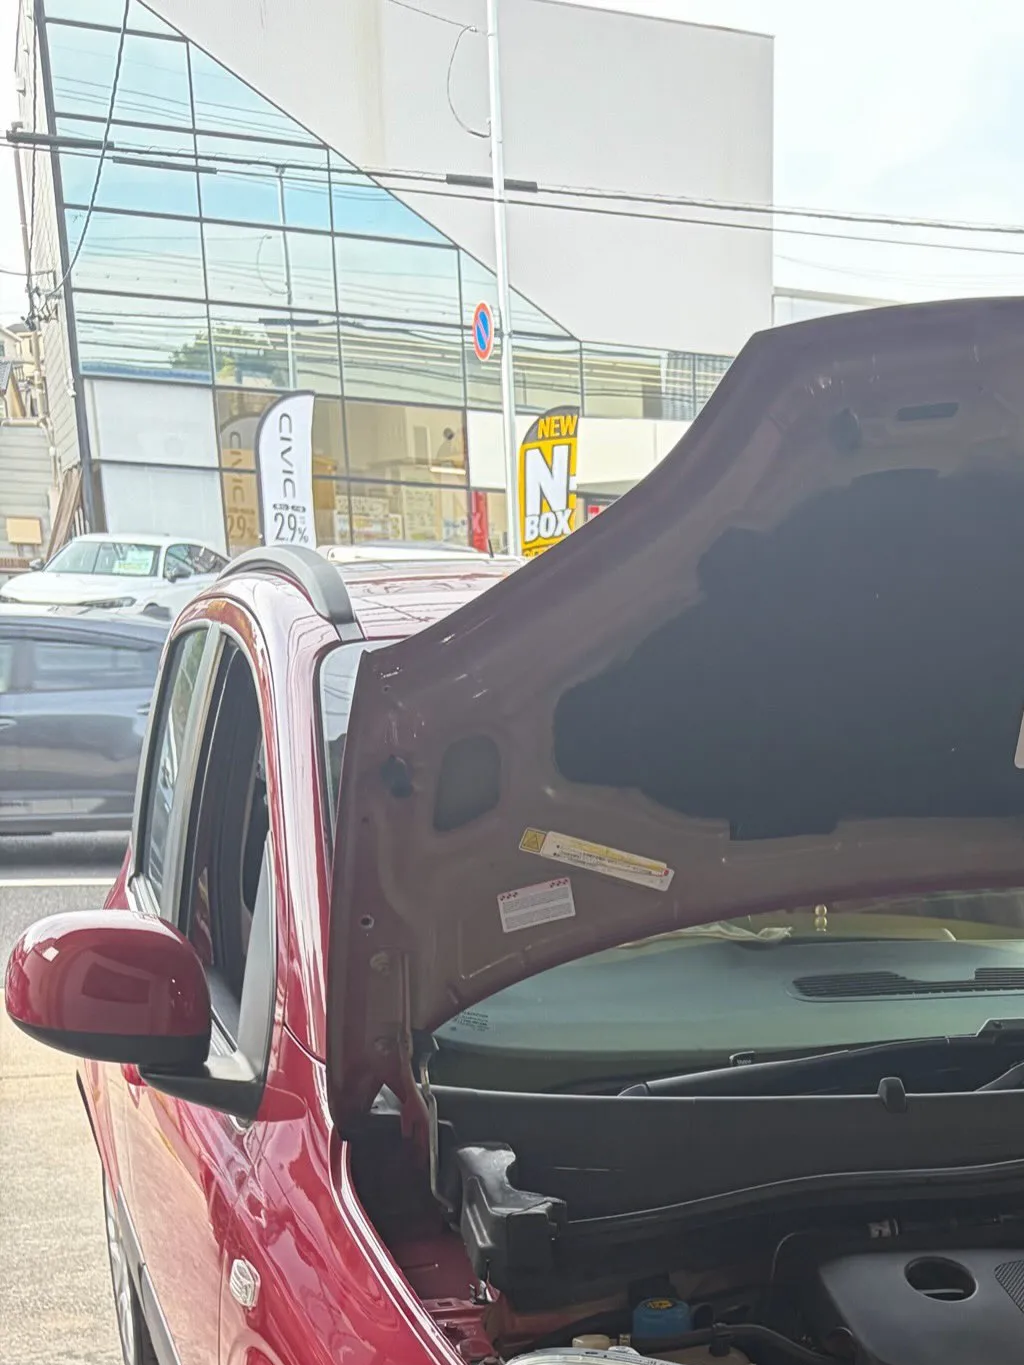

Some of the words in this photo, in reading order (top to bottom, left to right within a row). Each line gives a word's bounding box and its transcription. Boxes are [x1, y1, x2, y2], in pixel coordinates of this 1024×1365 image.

[537, 414, 579, 440] NEW
[278, 412, 297, 499] CIVIC
[524, 509, 573, 543] BOX
